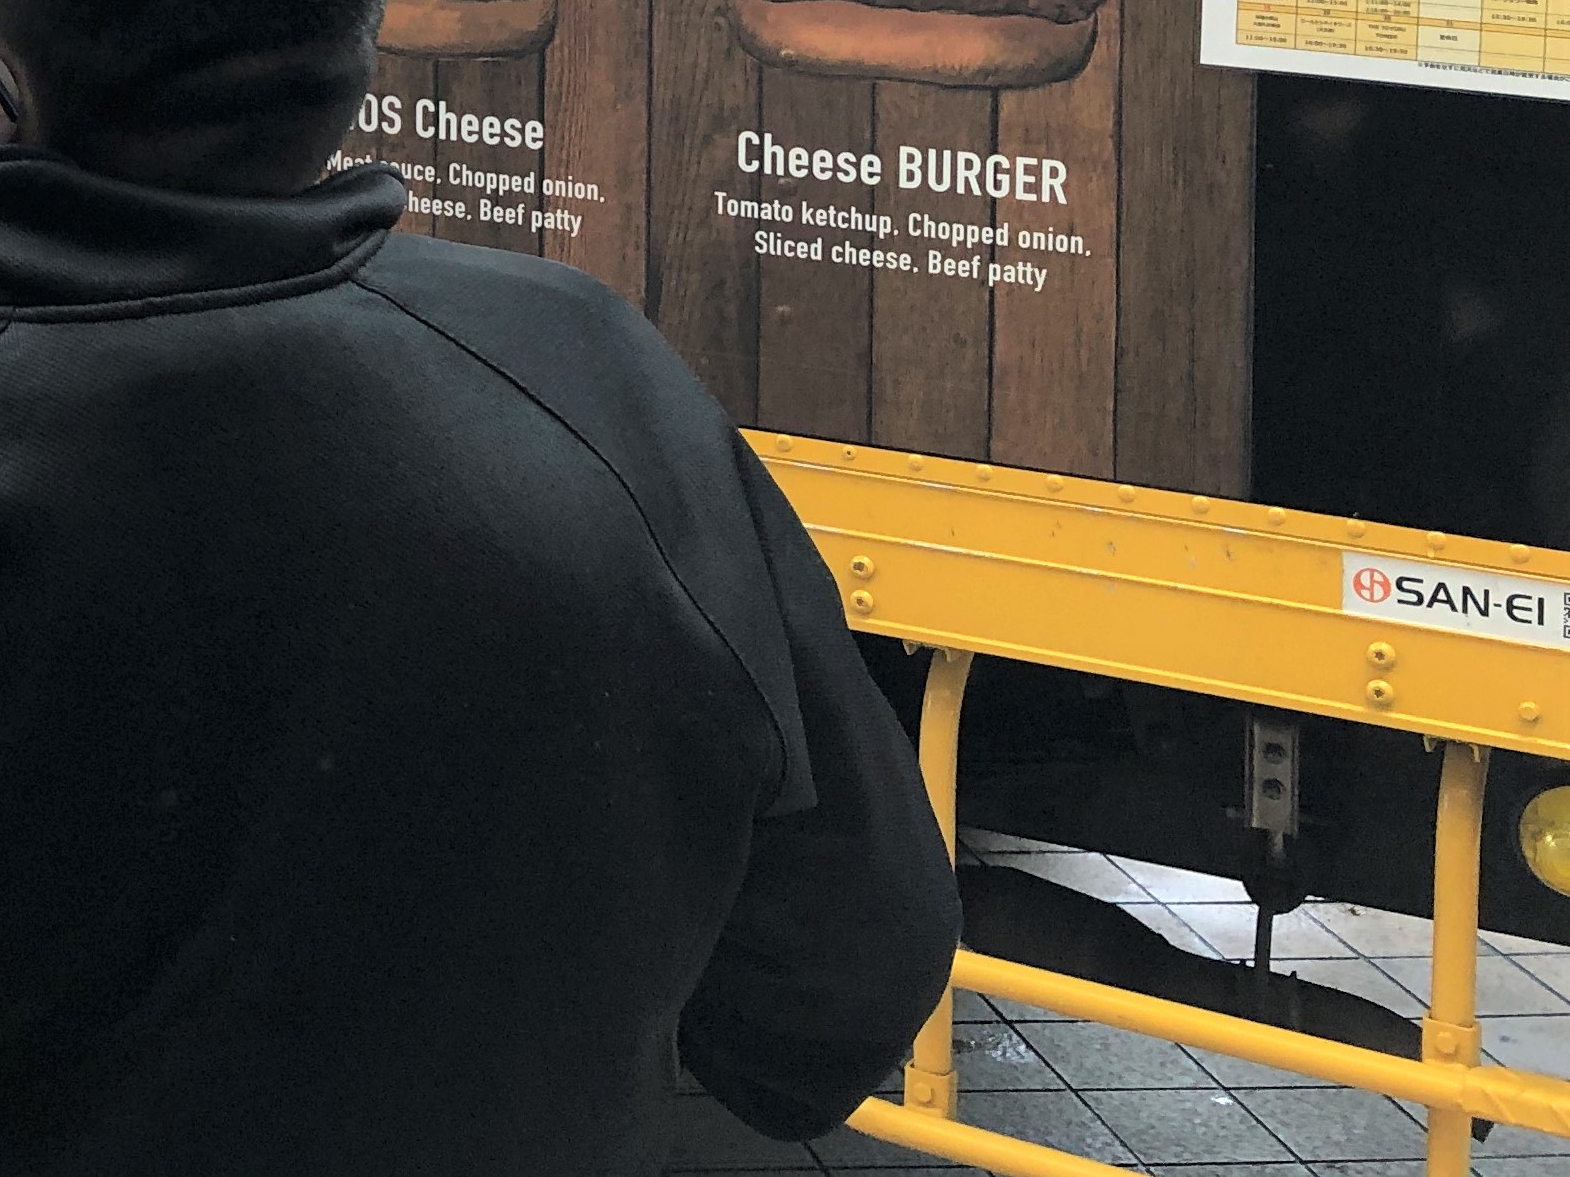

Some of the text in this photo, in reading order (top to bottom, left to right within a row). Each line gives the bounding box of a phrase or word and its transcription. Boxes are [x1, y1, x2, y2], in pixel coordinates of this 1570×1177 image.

[349, 93, 544, 150] OS Cheese
[380, 161, 442, 184] uce,
[449, 162, 535, 195] Chopped
[737, 130, 1068, 205] Cheese BURGER
[403, 190, 582, 237] heese, Beef patty
[714, 191, 793, 223] Tomato
[908, 212, 1009, 249] Chopped
[754, 231, 823, 262] Sliced
[929, 250, 982, 280] Beef
[988, 260, 1048, 292] patty
[1395, 576, 1545, 626] SAN-EI
